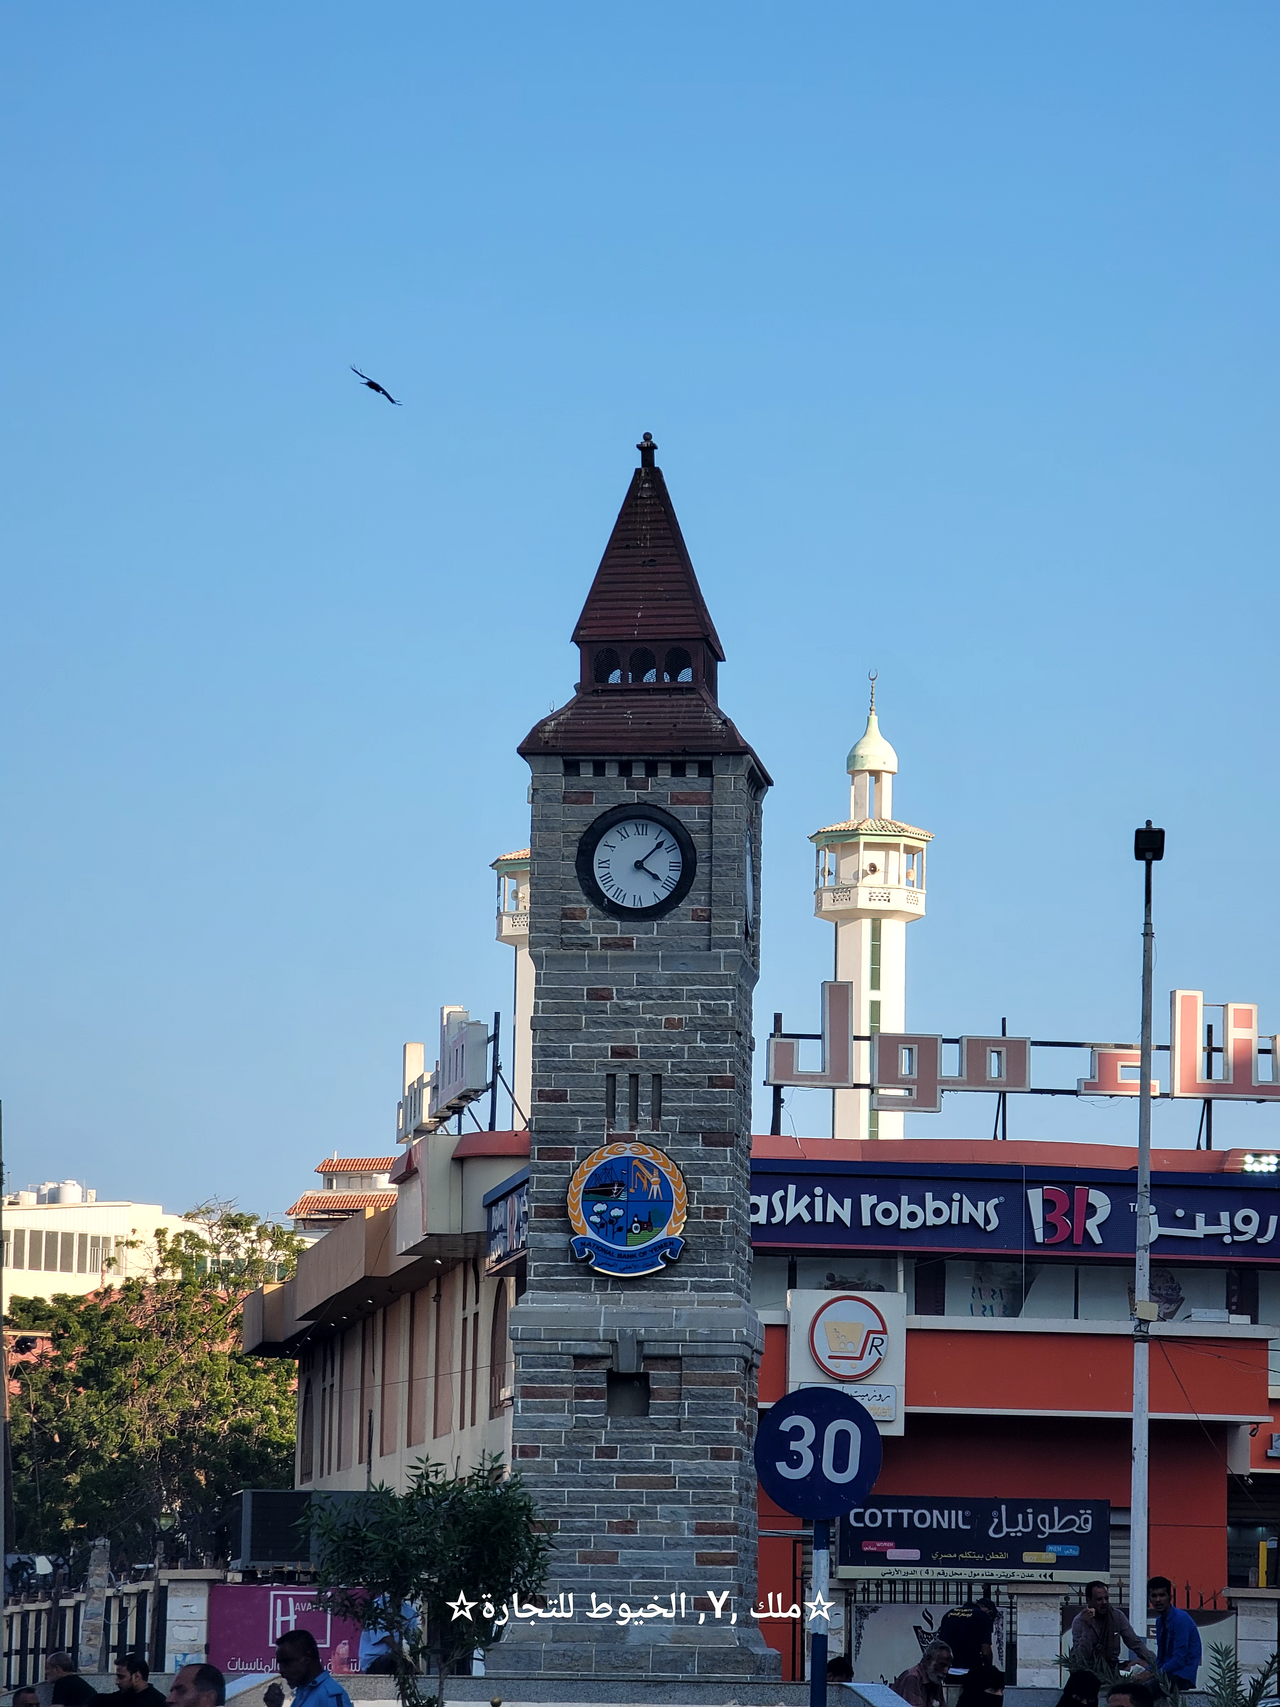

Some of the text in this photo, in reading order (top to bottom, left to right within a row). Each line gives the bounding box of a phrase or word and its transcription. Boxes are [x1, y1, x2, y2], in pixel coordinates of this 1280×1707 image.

[616, 826, 630, 841] XI
[634, 823, 648, 836] XII
[654, 829, 663, 840] I
[603, 840, 616, 852] X
[664, 843, 678, 854] II
[598, 858, 610, 869] IX
[669, 861, 681, 872] III
[599, 872, 615, 892] VIII
[612, 887, 627, 904] VII
[652, 891, 661, 903] V
[766, 980, 1280, 1113] ناء مول
[580, 1241, 615, 1258] NATIONAL
[638, 1250, 648, 1258] OF
[648, 1240, 674, 1254] YEMEN
[868, 1336, 883, 1356] R
[868, 1404, 893, 1417] rket
[775, 1415, 862, 1485] 30
[849, 1508, 971, 1530] COTTONIL
[988, 1504, 1092, 1539] قطونيل
[931, 1551, 957, 1561] مصري
[985, 1551, 1009, 1561] القطن
[881, 1567, 902, 1577] الأرضي
[902, 1568, 917, 1577] الدور
[936, 1569, 948, 1577] رقم
[1021, 1571, 1035, 1579] عدن
